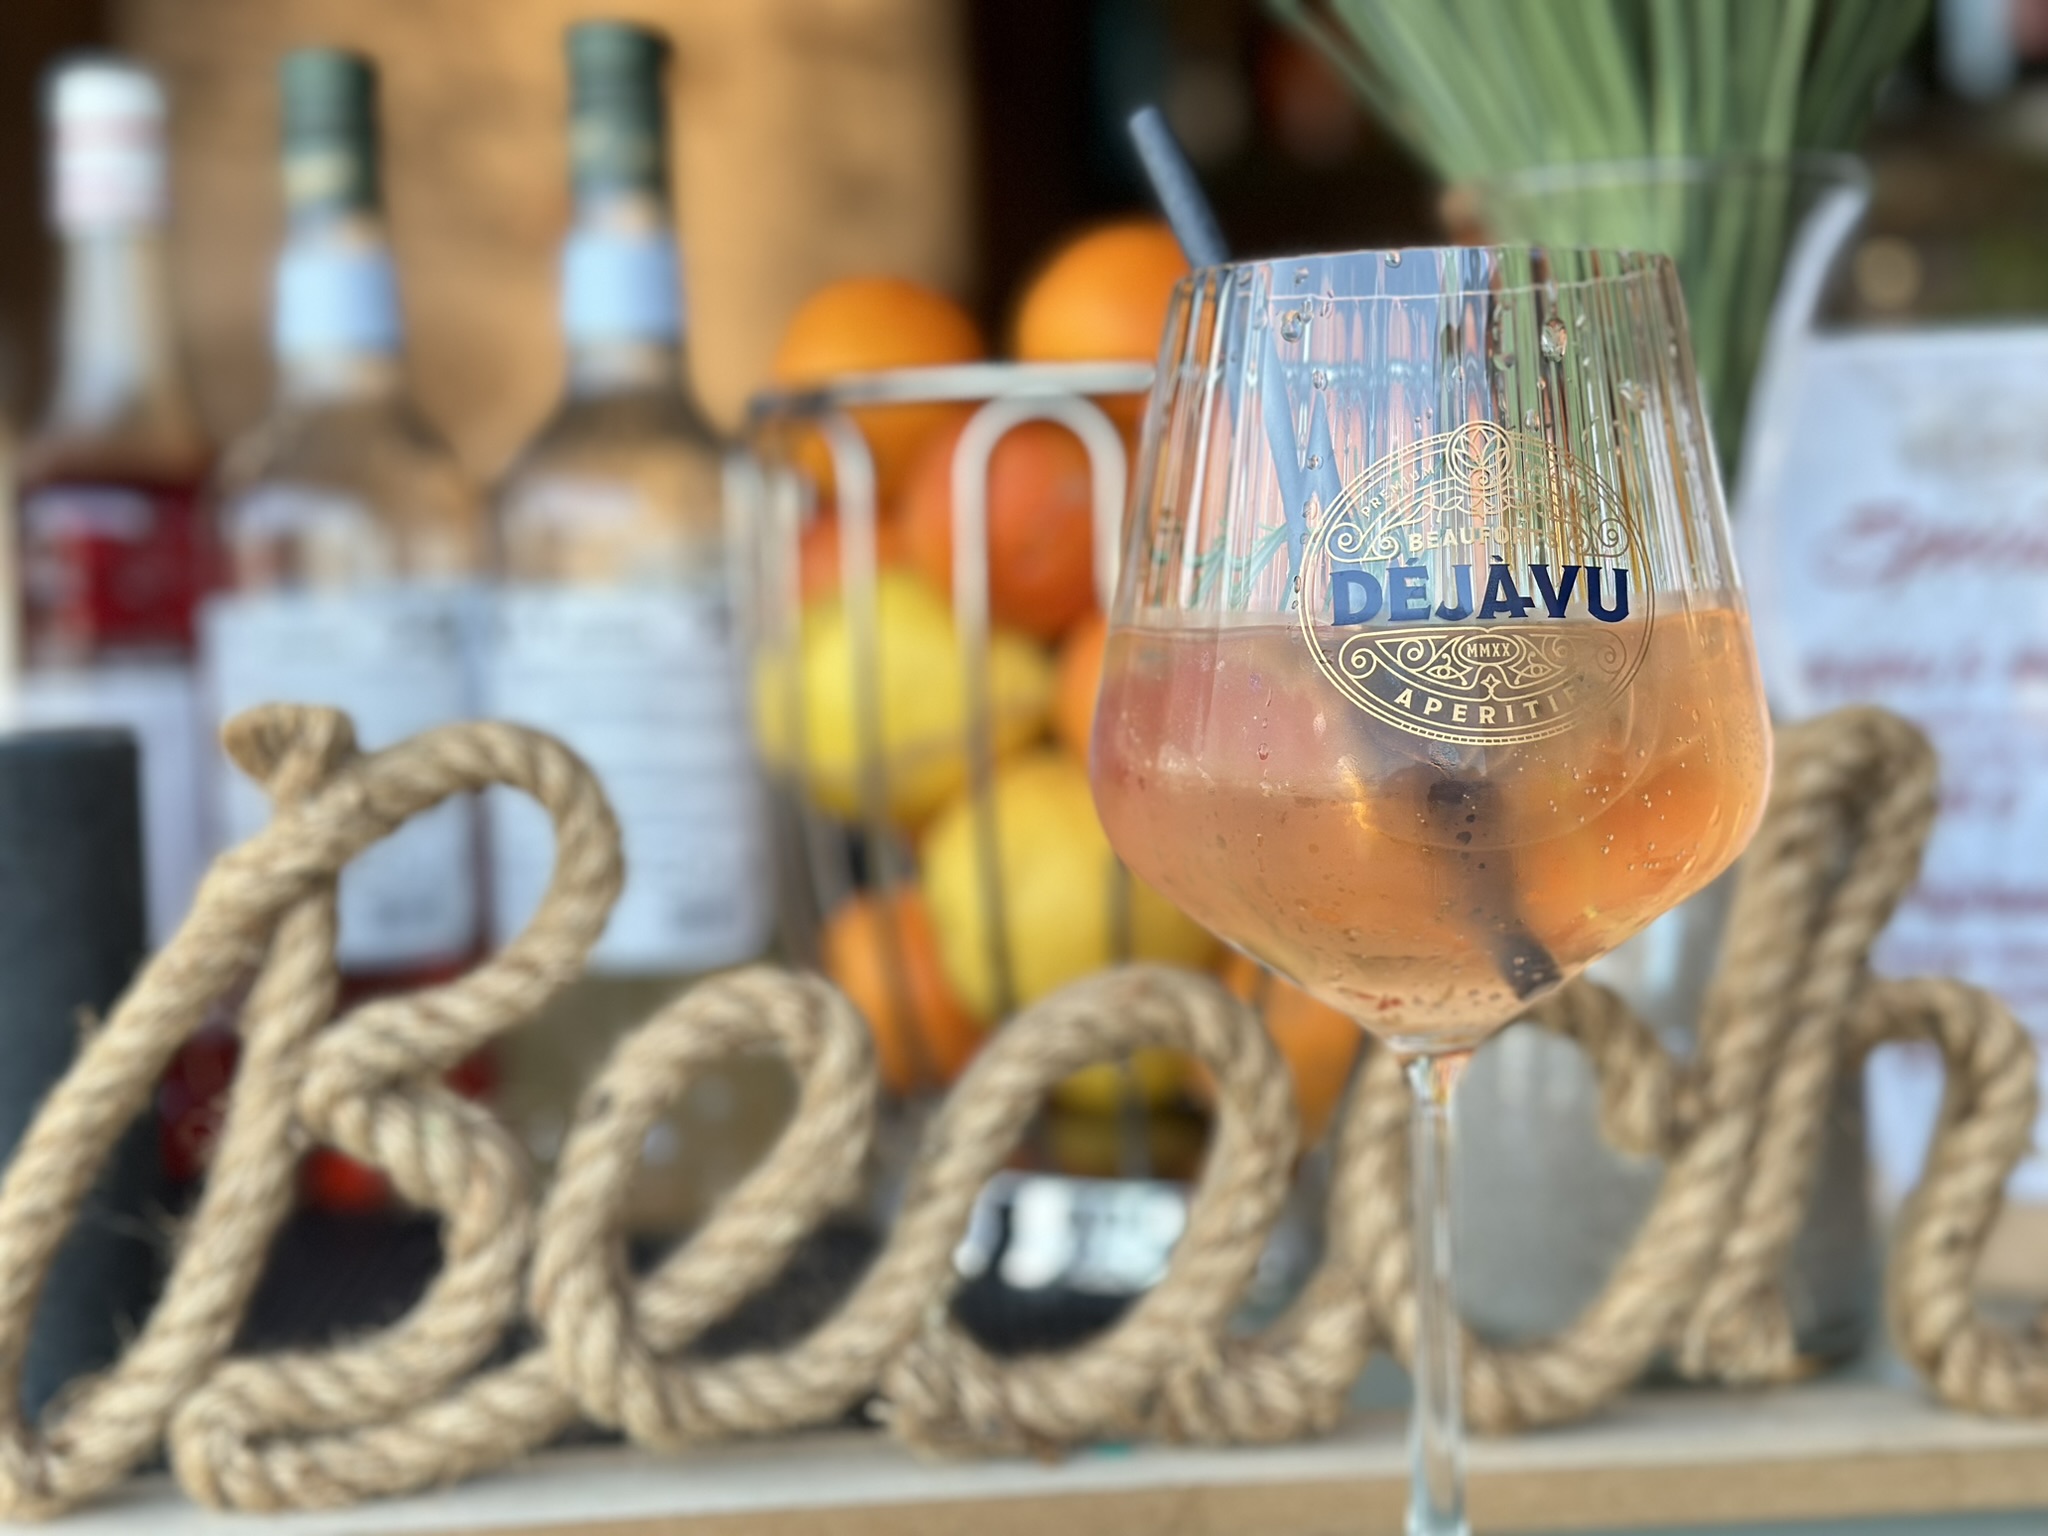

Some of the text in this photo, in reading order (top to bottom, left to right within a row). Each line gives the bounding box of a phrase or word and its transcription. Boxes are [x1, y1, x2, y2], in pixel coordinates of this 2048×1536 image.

[1361, 466, 1435, 518] PREMIUM
[1466, 642, 1511, 659] MMXX
[1393, 684, 1579, 725] APERITIF
